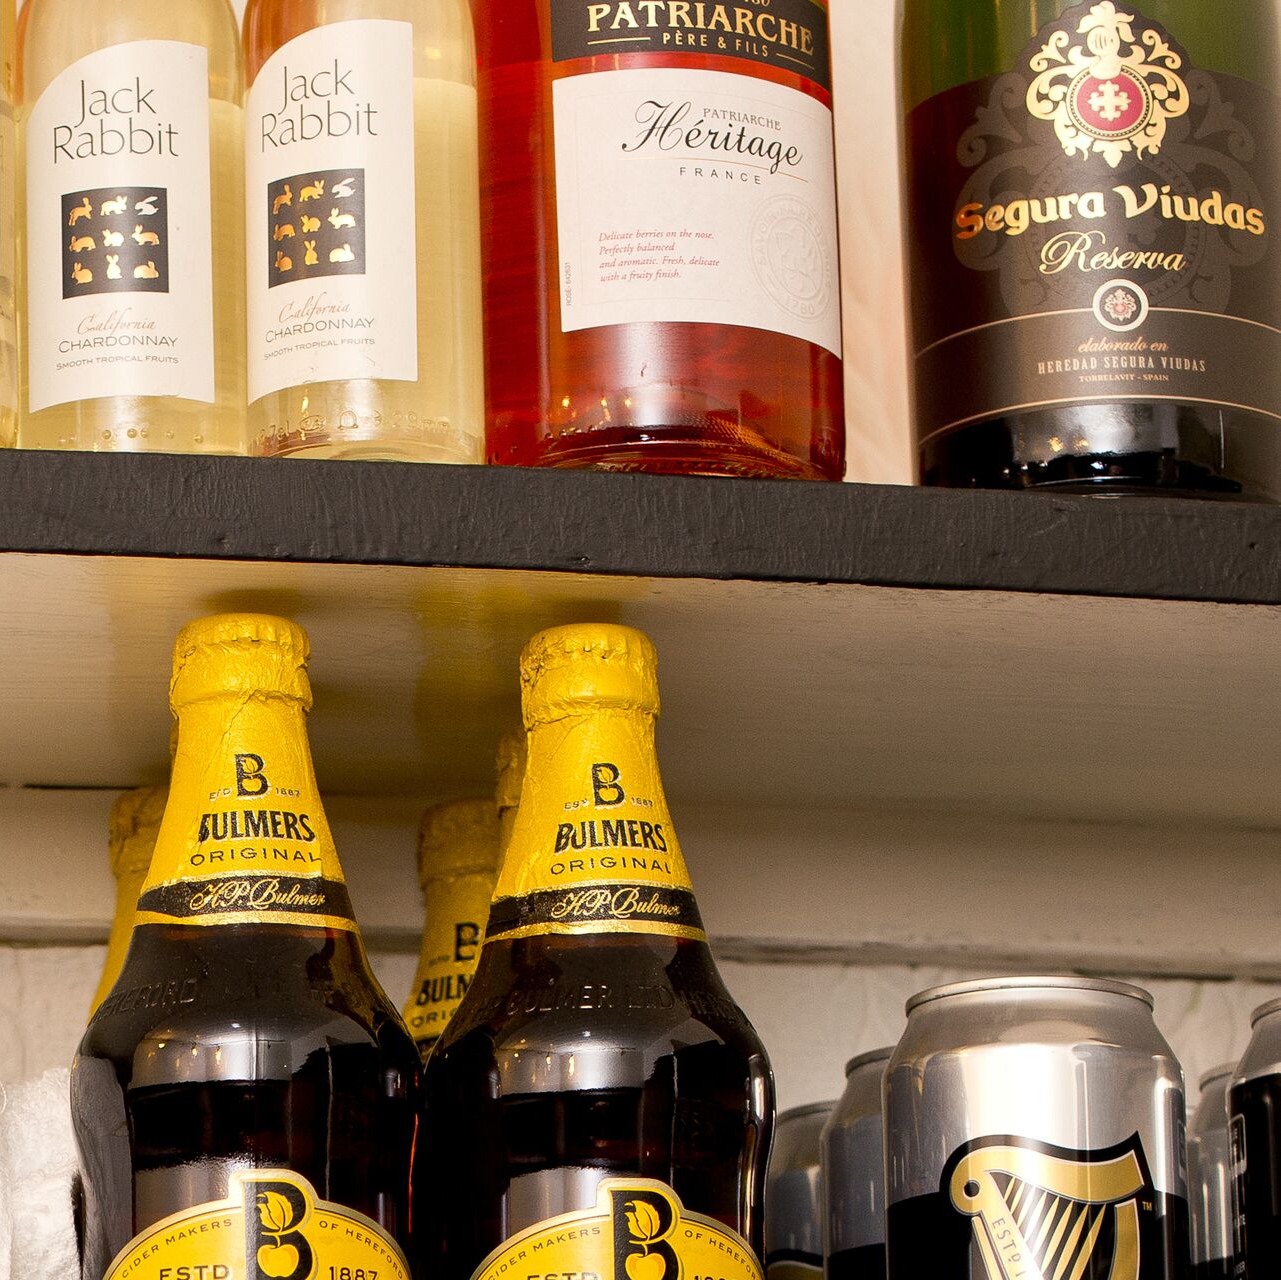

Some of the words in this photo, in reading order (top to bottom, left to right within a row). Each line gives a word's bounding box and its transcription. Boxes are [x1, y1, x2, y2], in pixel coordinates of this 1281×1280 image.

[587, 0, 815, 56] PATRIARCHE
[662, 32, 708, 48] PÈRE
[735, 41, 770, 57] FILS
[277, 58, 355, 116] Jack
[76, 77, 158, 128] Jack
[261, 100, 379, 153] Rabbit
[703, 107, 782, 132] PATRIARCHE
[53, 116, 180, 165] Rabbit
[621, 99, 804, 175] Héritage
[679, 166, 762, 185] FRANCE
[955, 189, 1107, 240] Segura
[1112, 182, 1266, 236] Viudas
[1039, 229, 1187, 275] Reserva
[77, 306, 157, 336] California
[278, 291, 352, 322] California
[58, 334, 179, 355] CHARDONNAY
[265, 316, 375, 343] CHARDONNAY
[1077, 335, 1148, 353] elaborado
[1150, 340, 1169, 352] en
[56, 356, 94, 371] SMOOTH
[95, 355, 144, 366] TROPICAL
[145, 354, 180, 365] FRUITS
[1037, 356, 1098, 375] HEREDAD
[1103, 355, 1155, 369] SEGURA
[1161, 358, 1207, 373] VIUDAS
[1142, 373, 1170, 382] SPAIN
[197, 809, 316, 844] BULMERS
[553, 818, 668, 854] BULMERS
[189, 846, 323, 868] ORIGINAL
[549, 856, 673, 875] ORIGINAL
[120, 1241, 162, 1279] CIDER
[165, 1218, 233, 1245] MAKERS
[319, 1219, 341, 1232] OF
[345, 1226, 405, 1280] HEREFORD
